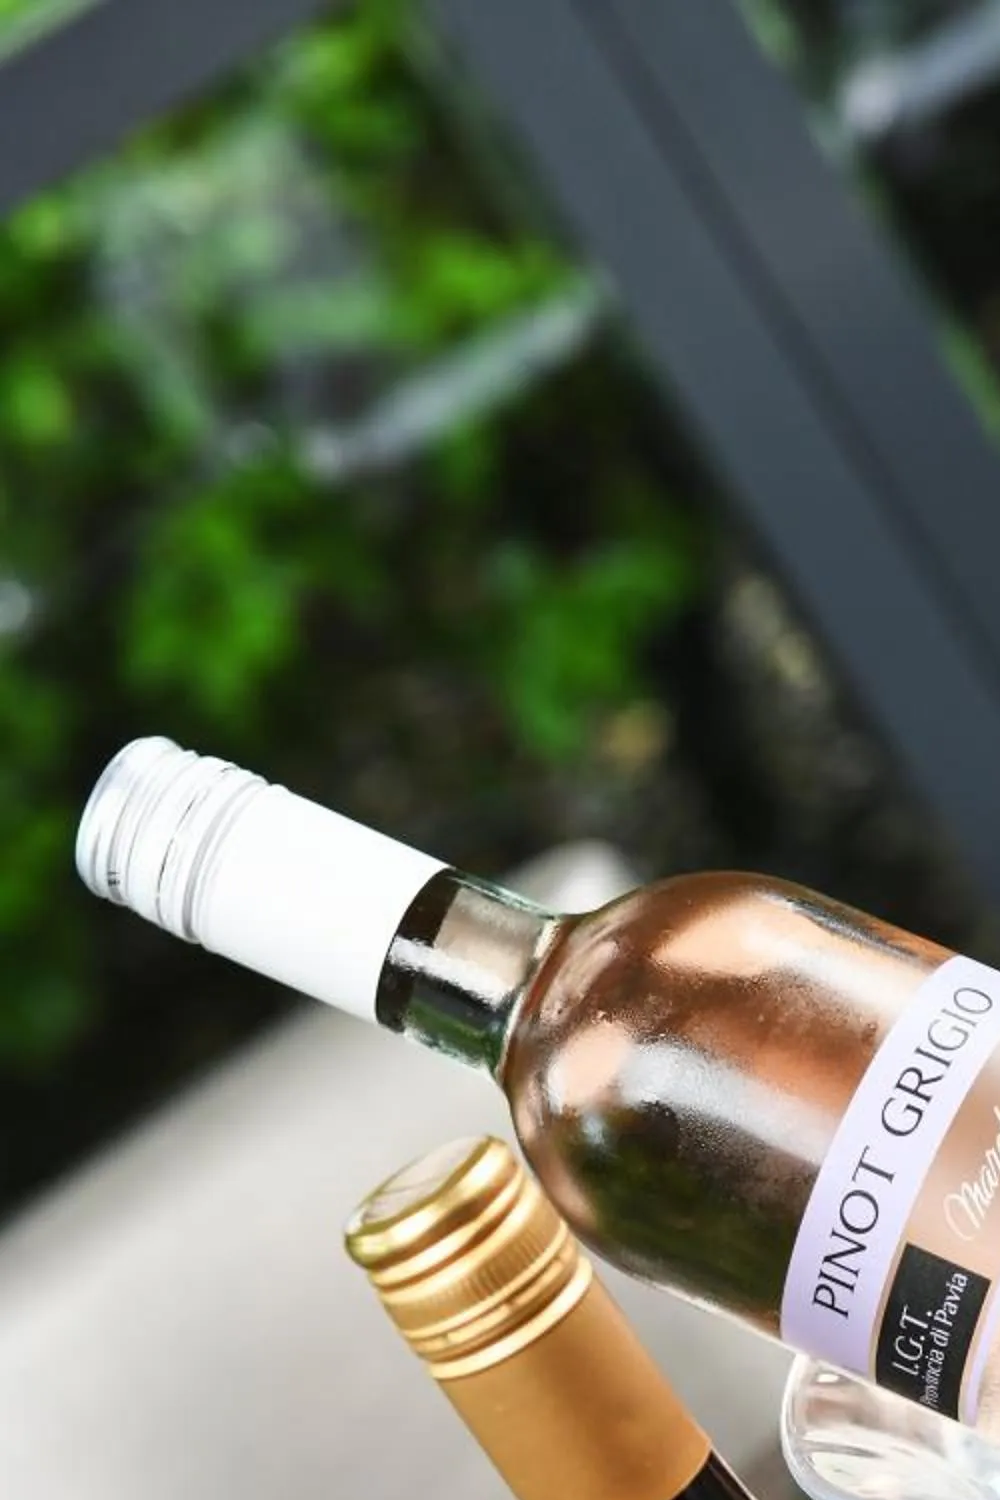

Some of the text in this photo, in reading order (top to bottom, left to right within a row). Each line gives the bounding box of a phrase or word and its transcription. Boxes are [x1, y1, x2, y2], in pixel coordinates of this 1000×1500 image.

[811, 986, 994, 1319] PINOT GRIGIO
[933, 1272, 970, 1328] Pavia
[891, 1304, 934, 1376] I.G.T.
[930, 1325, 951, 1348] di
